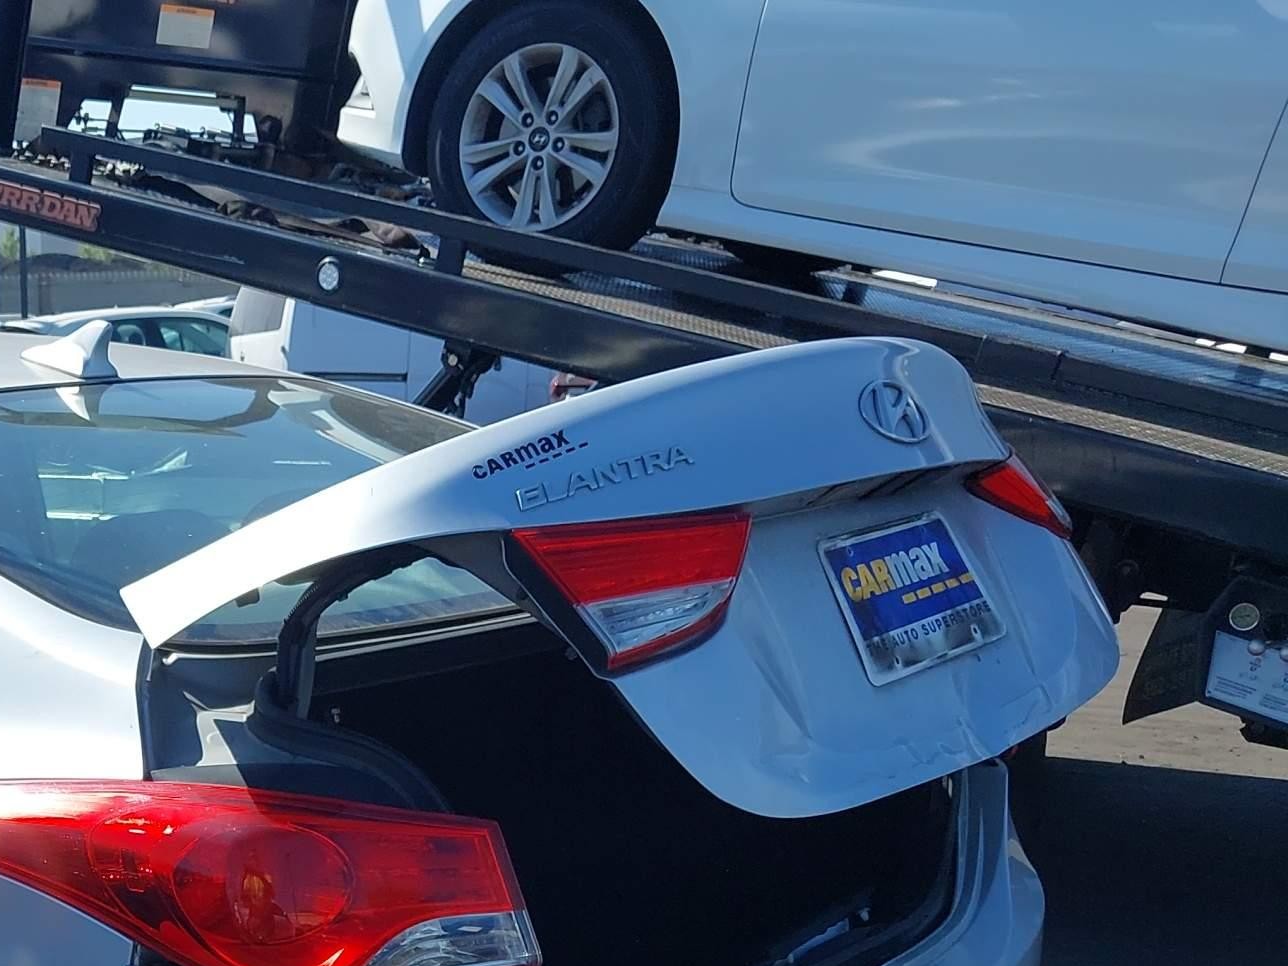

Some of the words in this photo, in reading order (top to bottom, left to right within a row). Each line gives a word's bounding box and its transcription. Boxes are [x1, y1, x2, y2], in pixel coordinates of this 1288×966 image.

[515, 446, 696, 512] ELANTRA
[841, 542, 949, 601] CARmax
[890, 627, 919, 649] AUTO
[921, 601, 991, 635] SUPERSTORE
